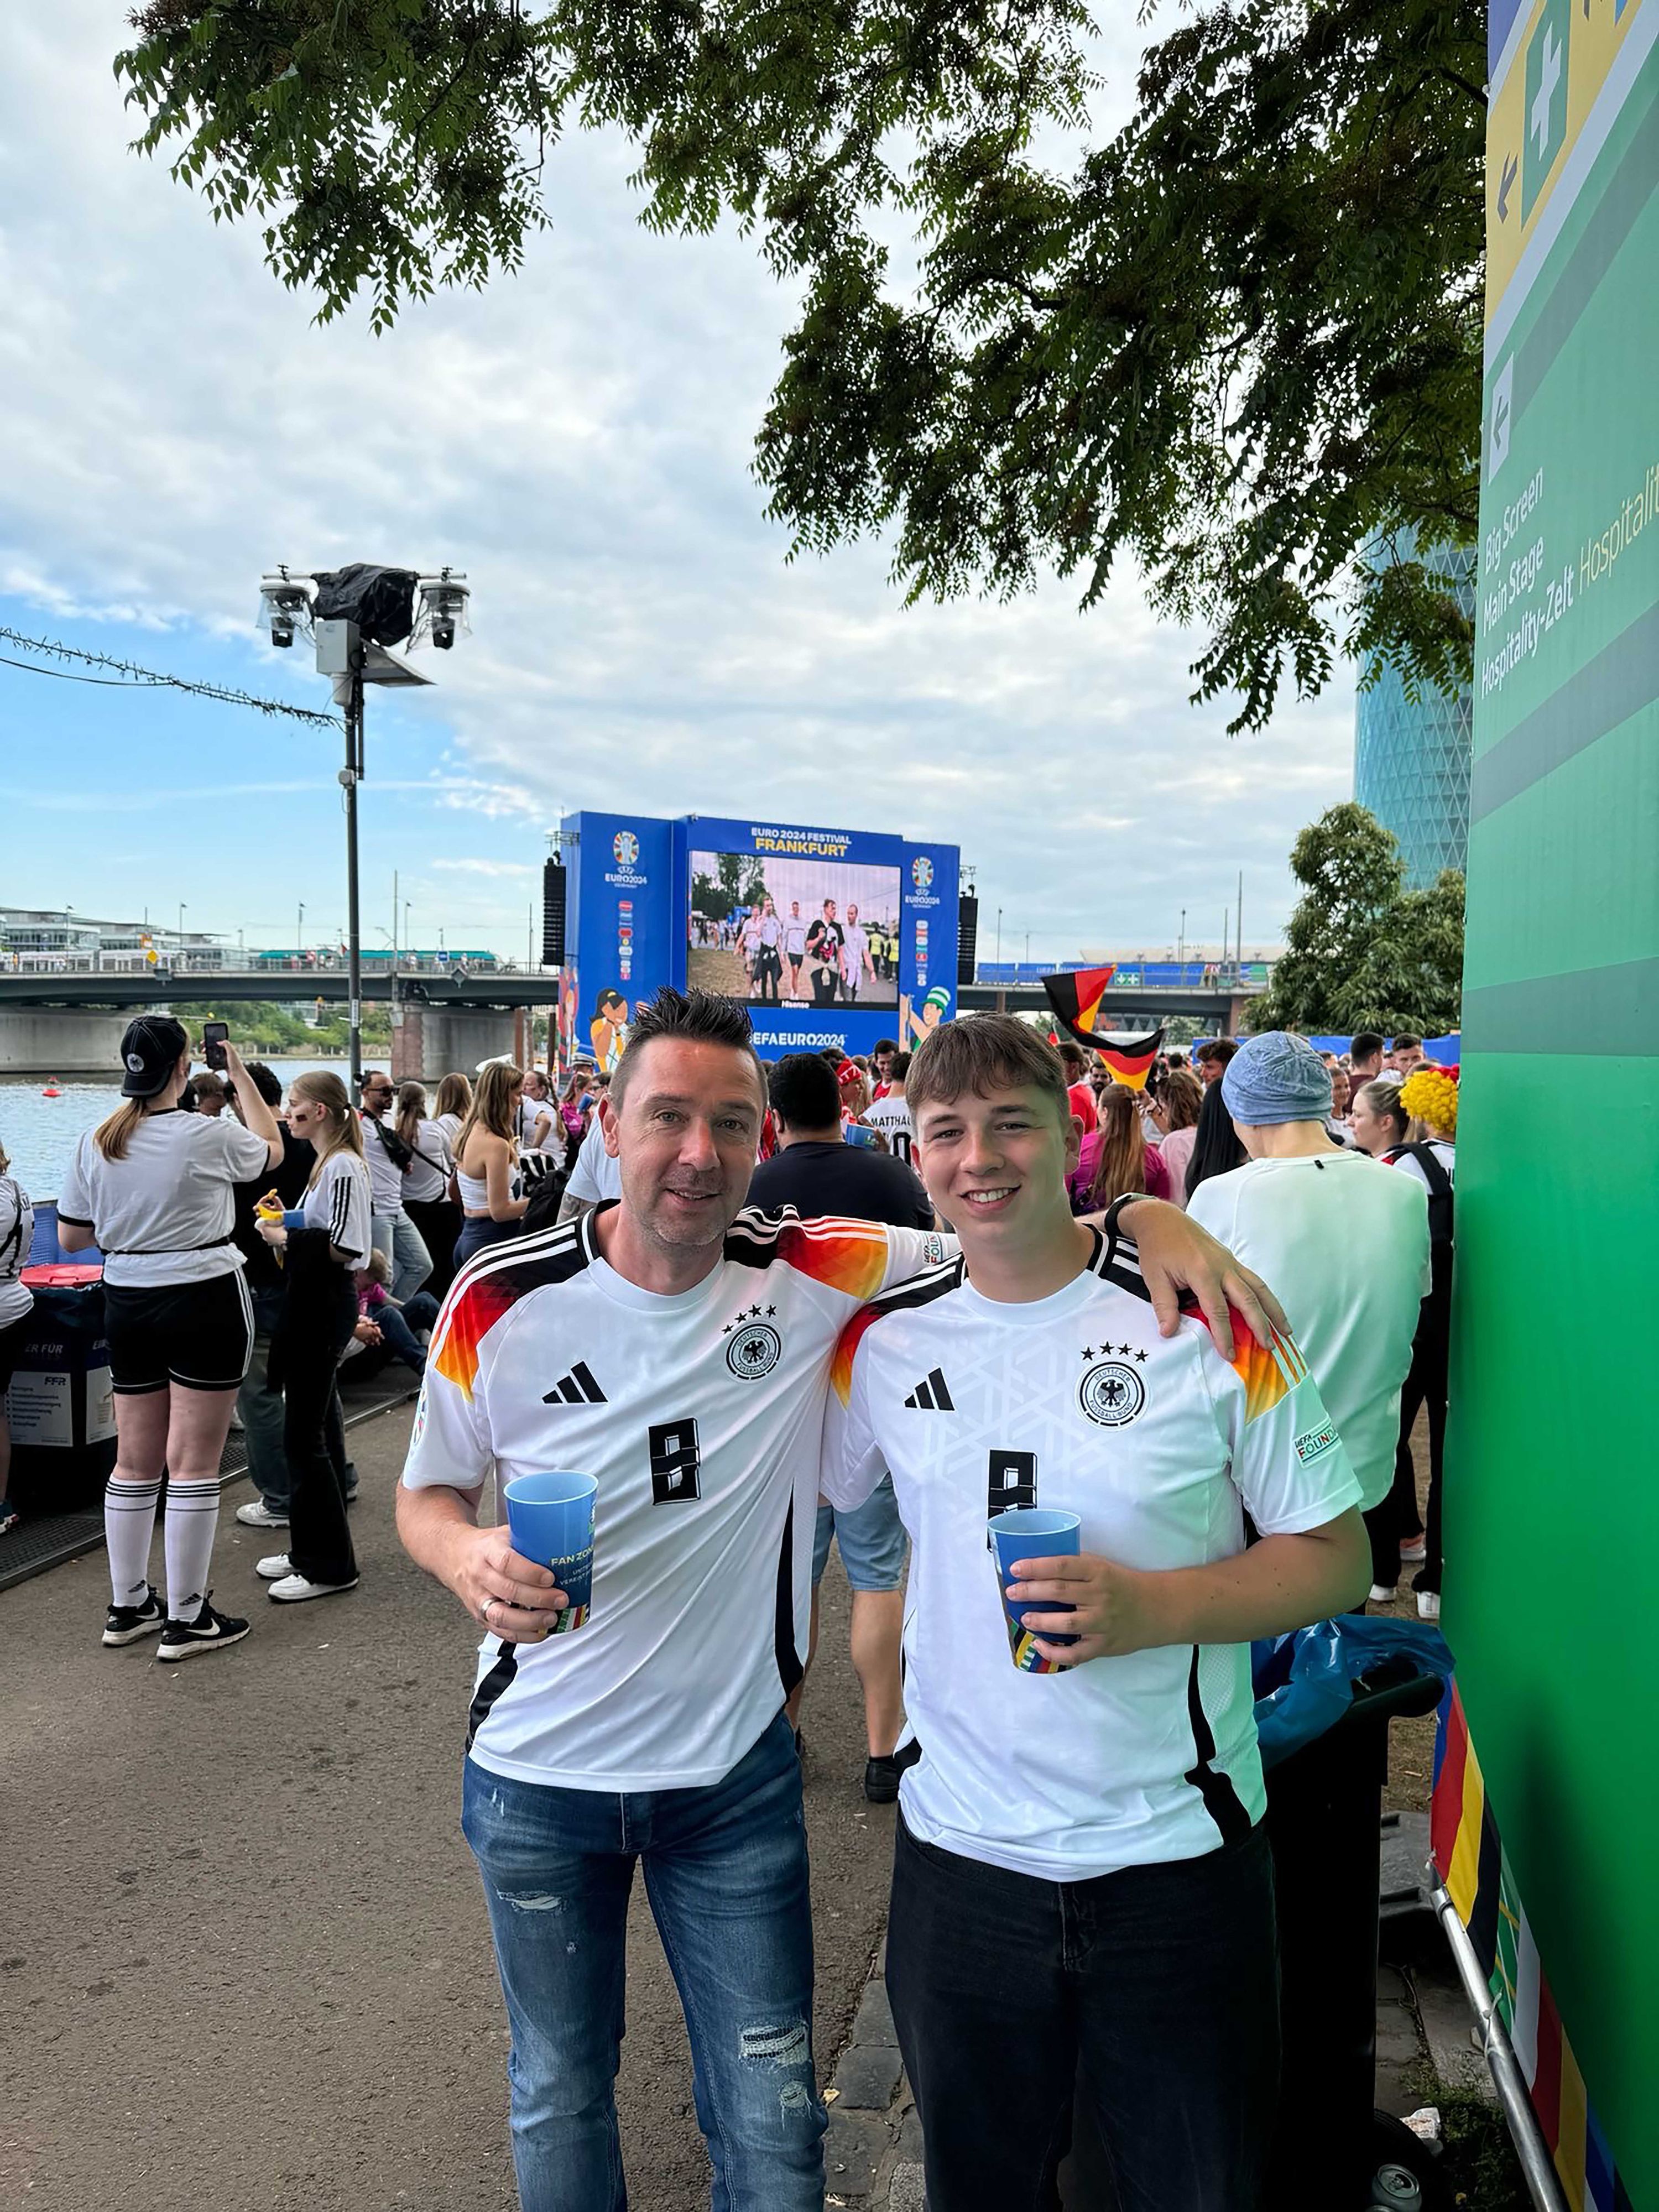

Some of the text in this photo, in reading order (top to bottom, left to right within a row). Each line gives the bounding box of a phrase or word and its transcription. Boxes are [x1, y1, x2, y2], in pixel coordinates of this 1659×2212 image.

[1485, 466, 1543, 575] Big Screen
[1481, 462, 1659, 700] Hospitality-Zelt Hospitalit
[1484, 536, 1543, 637] Main Stage
[751, 827, 852, 844] EURO 2024 FESTIVAL
[755, 837, 847, 857] FRANKFURT
[750, 1032, 845, 1047] EFAEURO2024
[1094, 1369, 1131, 1382] DEUTSCHER
[649, 1417, 701, 1505] 8
[551, 1544, 594, 1567] FAN ZON
